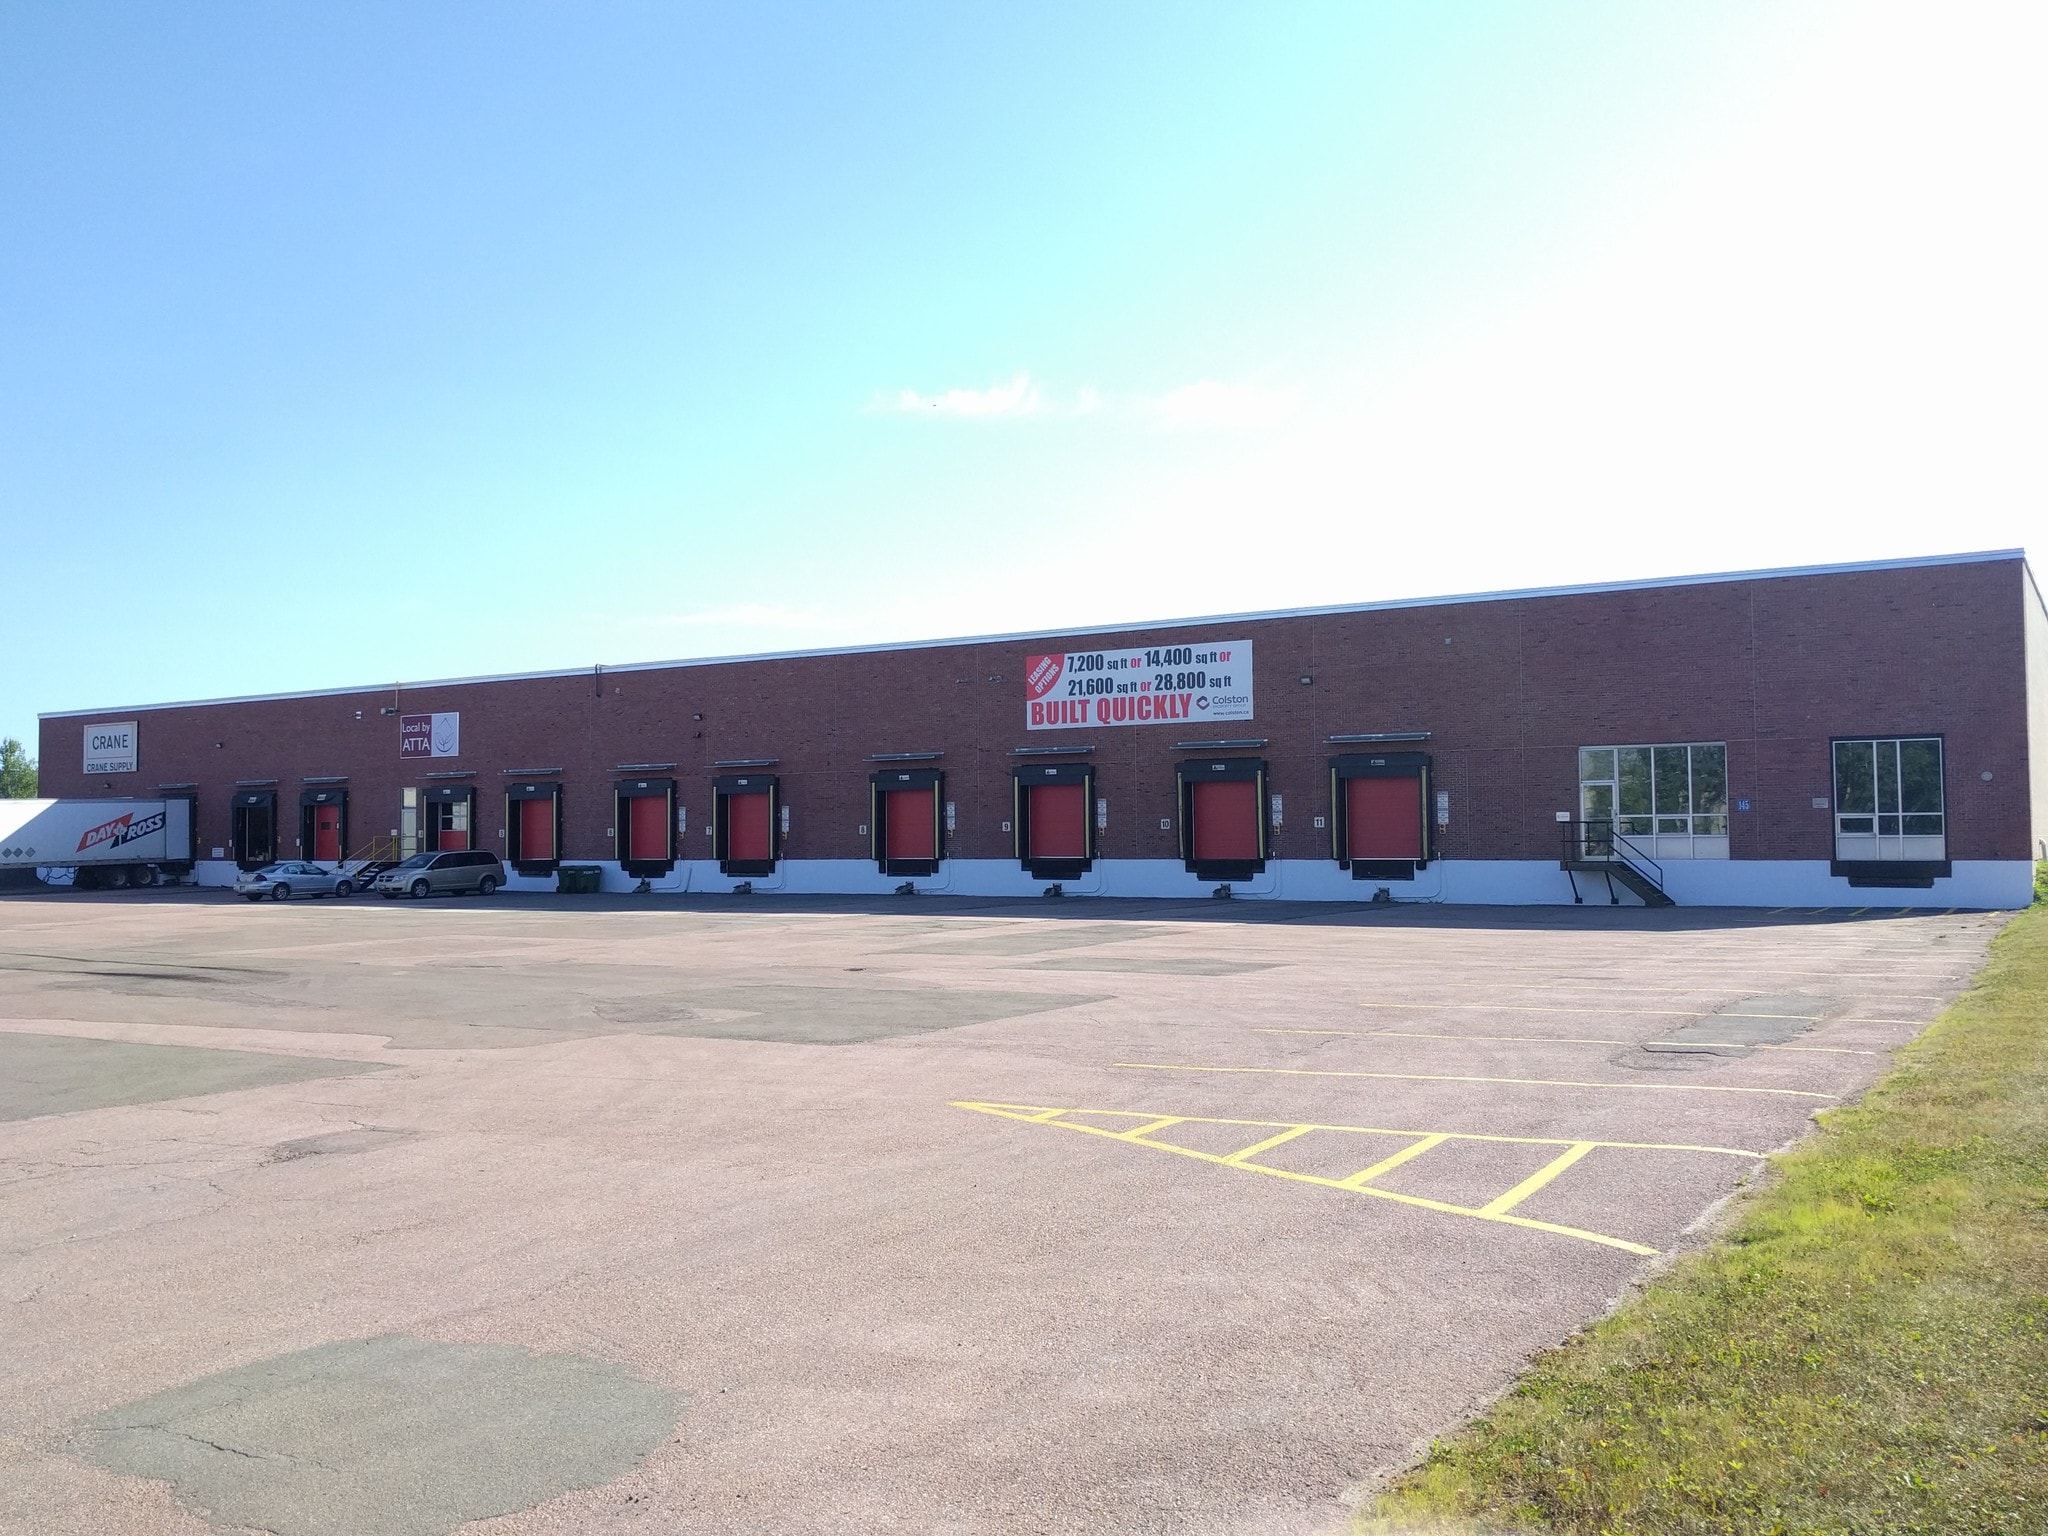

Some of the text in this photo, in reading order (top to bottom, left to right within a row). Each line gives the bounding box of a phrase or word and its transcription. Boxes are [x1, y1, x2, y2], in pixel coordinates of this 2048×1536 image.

[1067, 647, 1231, 674] 7,200 sq ft or 14,400 sq ft or
[1028, 656, 1052, 686] LEASING
[1034, 664, 1060, 694] OPTIONS
[1068, 671, 1232, 697] 21,600 sq ft or 28,800 sq ft
[1212, 695, 1249, 705] Colston
[1031, 693, 1193, 725] BUILT QUICKLY
[402, 721, 431, 734] Local by
[92, 734, 129, 750] CRANE
[402, 737, 430, 751] ATTA
[86, 761, 134, 773] CRANE SUPPLY
[1161, 820, 1170, 828] 10
[1315, 818, 1324, 827] 11
[86, 815, 163, 847] DAY ROSS
